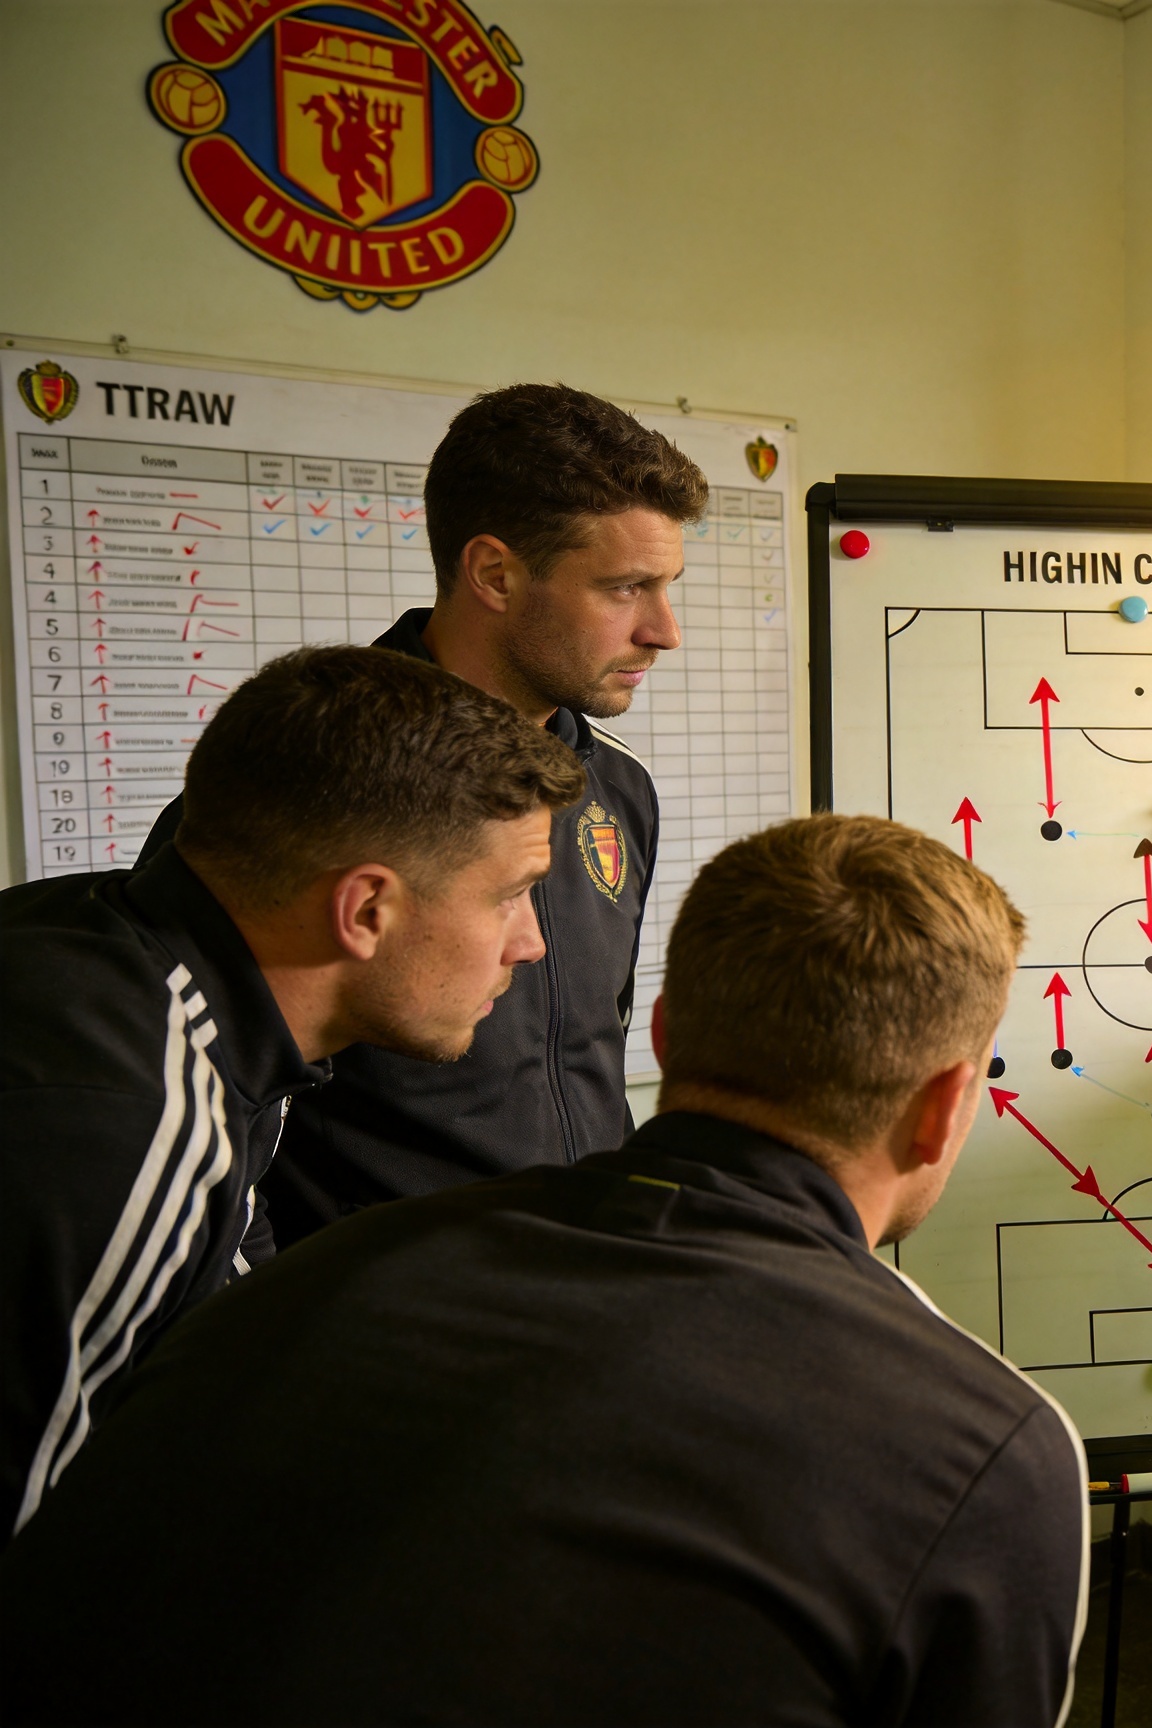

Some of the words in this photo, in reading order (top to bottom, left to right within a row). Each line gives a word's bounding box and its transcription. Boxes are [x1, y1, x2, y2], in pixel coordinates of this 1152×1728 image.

[195, 0, 498, 99] MASTER
[96, 381, 236, 426] TTRAW
[40, 478, 49, 495] 1
[40, 506, 55, 526] 2
[43, 535, 54, 552] 3
[42, 562, 55, 580] 4
[1003, 551, 1123, 584] HIGHIN
[44, 590, 57, 605] 4
[46, 618, 59, 636] 5
[48, 646, 62, 663] 6
[47, 674, 62, 693] 7
[50, 702, 63, 720] 8
[51, 817, 77, 834] 20
